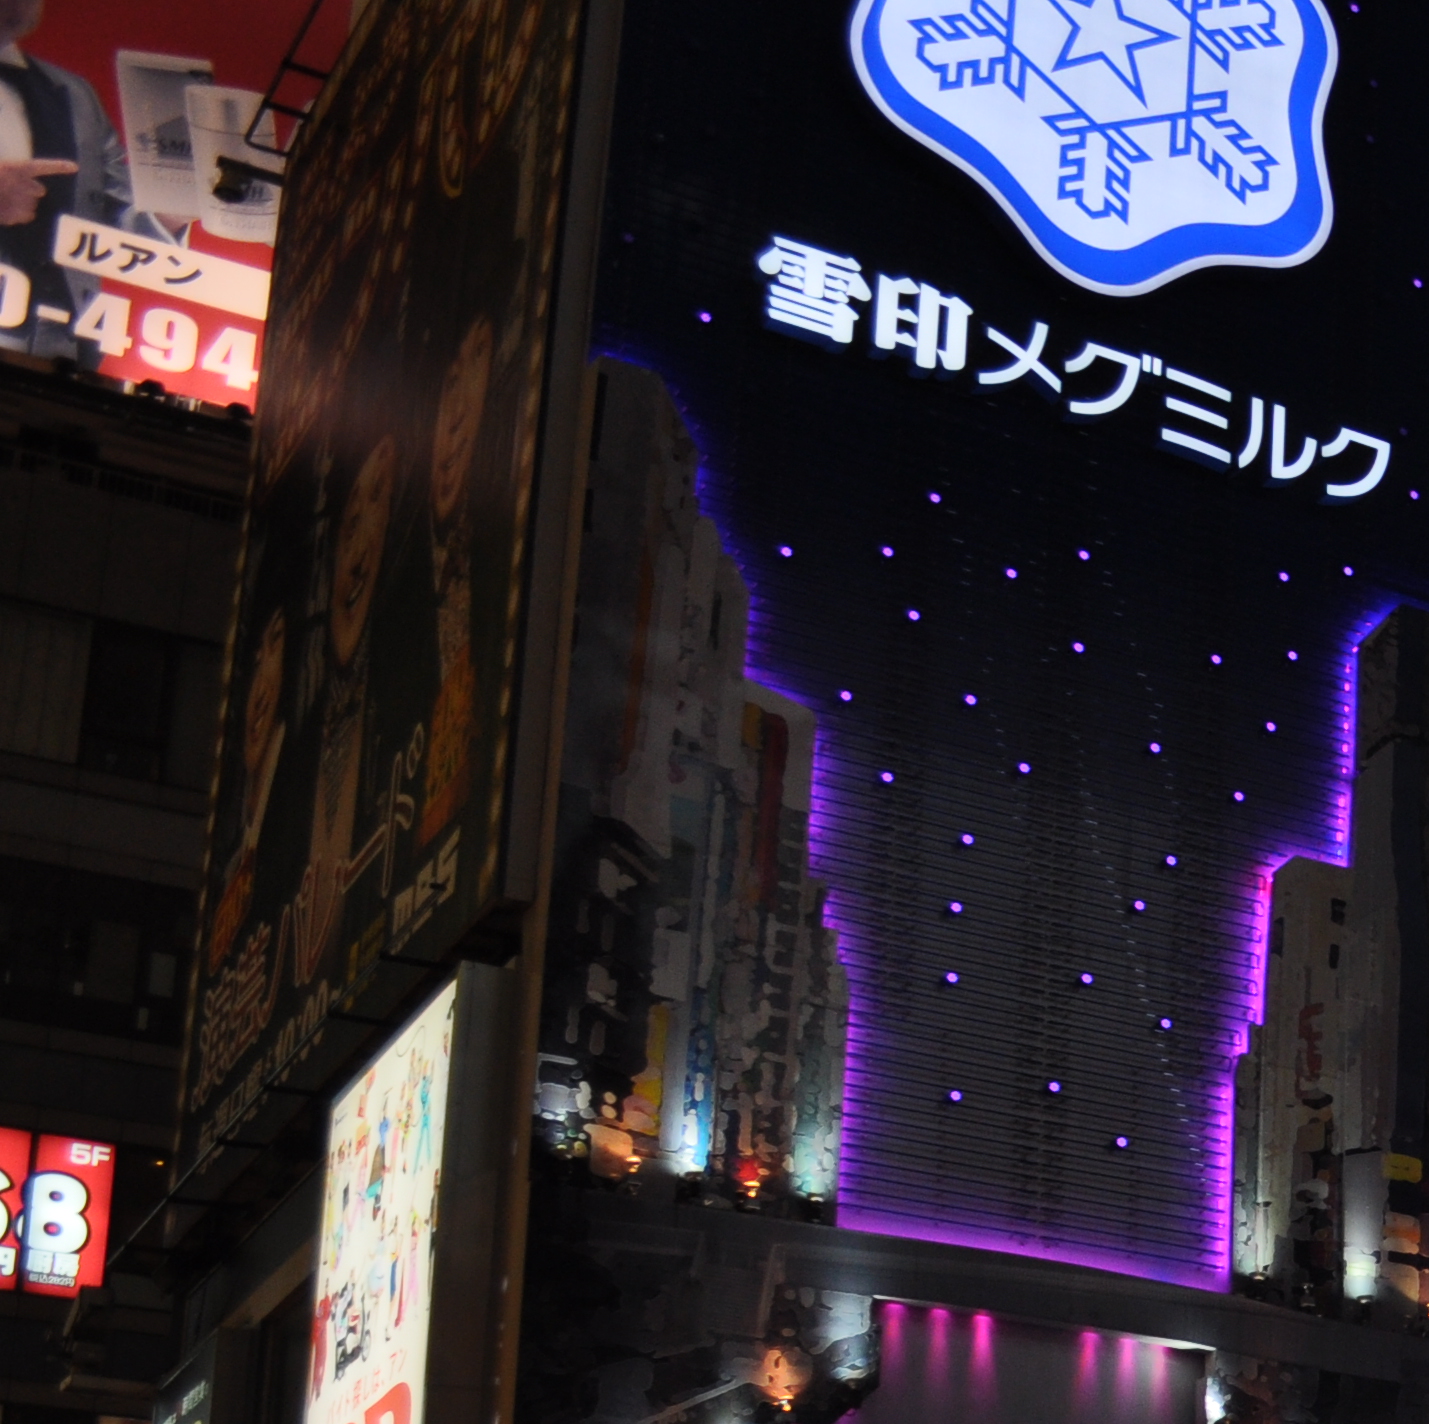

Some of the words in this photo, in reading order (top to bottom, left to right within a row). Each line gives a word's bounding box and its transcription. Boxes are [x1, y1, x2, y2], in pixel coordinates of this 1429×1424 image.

[69, 229, 202, 286] ルアン
[756, 235, 1392, 500] 雪印メグミルク
[70, 1143, 111, 1166] 5F
